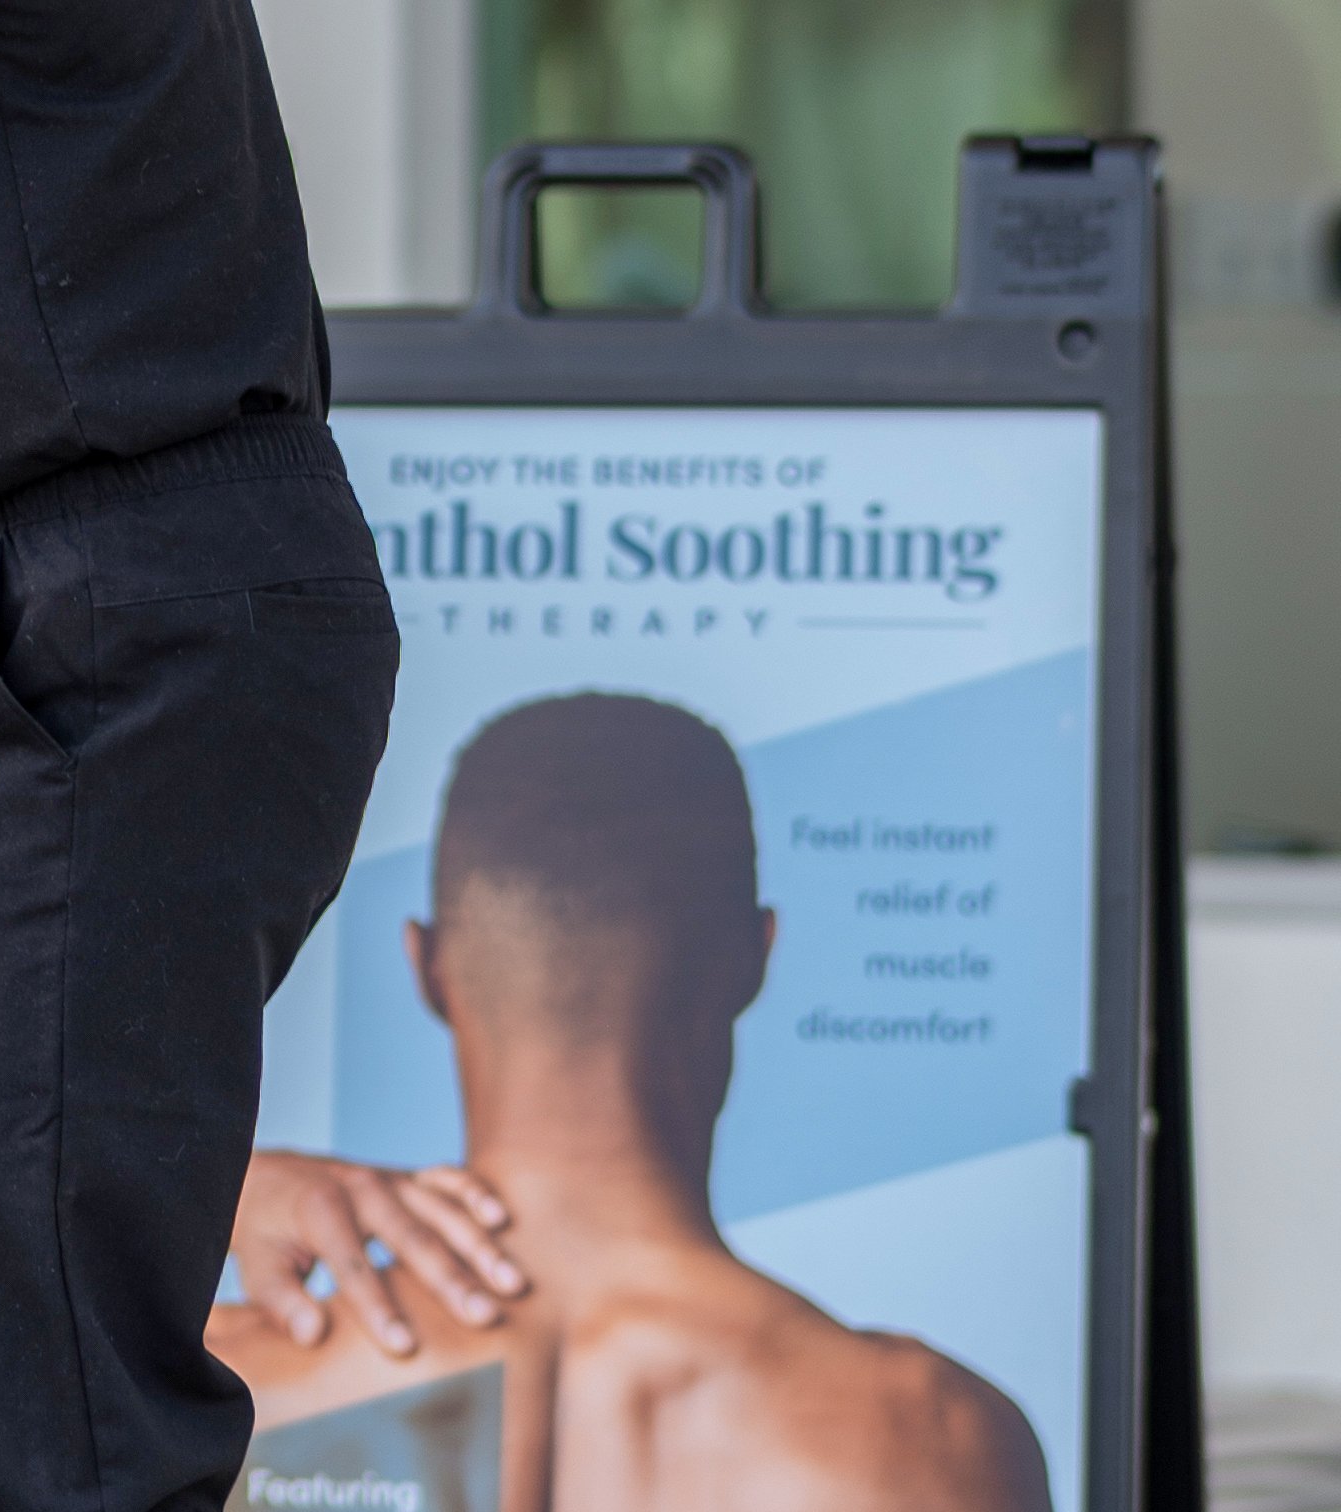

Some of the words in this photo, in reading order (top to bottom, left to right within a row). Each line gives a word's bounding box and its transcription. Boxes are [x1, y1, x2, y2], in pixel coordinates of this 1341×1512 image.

[389, 454, 498, 494] ENJOY
[514, 454, 579, 487] THE
[594, 454, 764, 488] BENEFITS
[777, 454, 827, 488] OF
[368, 498, 581, 581] nthol
[607, 501, 1001, 601] Soothing
[790, 815, 861, 850] Feel
[872, 817, 994, 851] instant
[857, 880, 950, 915] relief
[958, 880, 997, 916] of
[866, 947, 991, 978] muscle
[797, 1008, 994, 1043] discomfort
